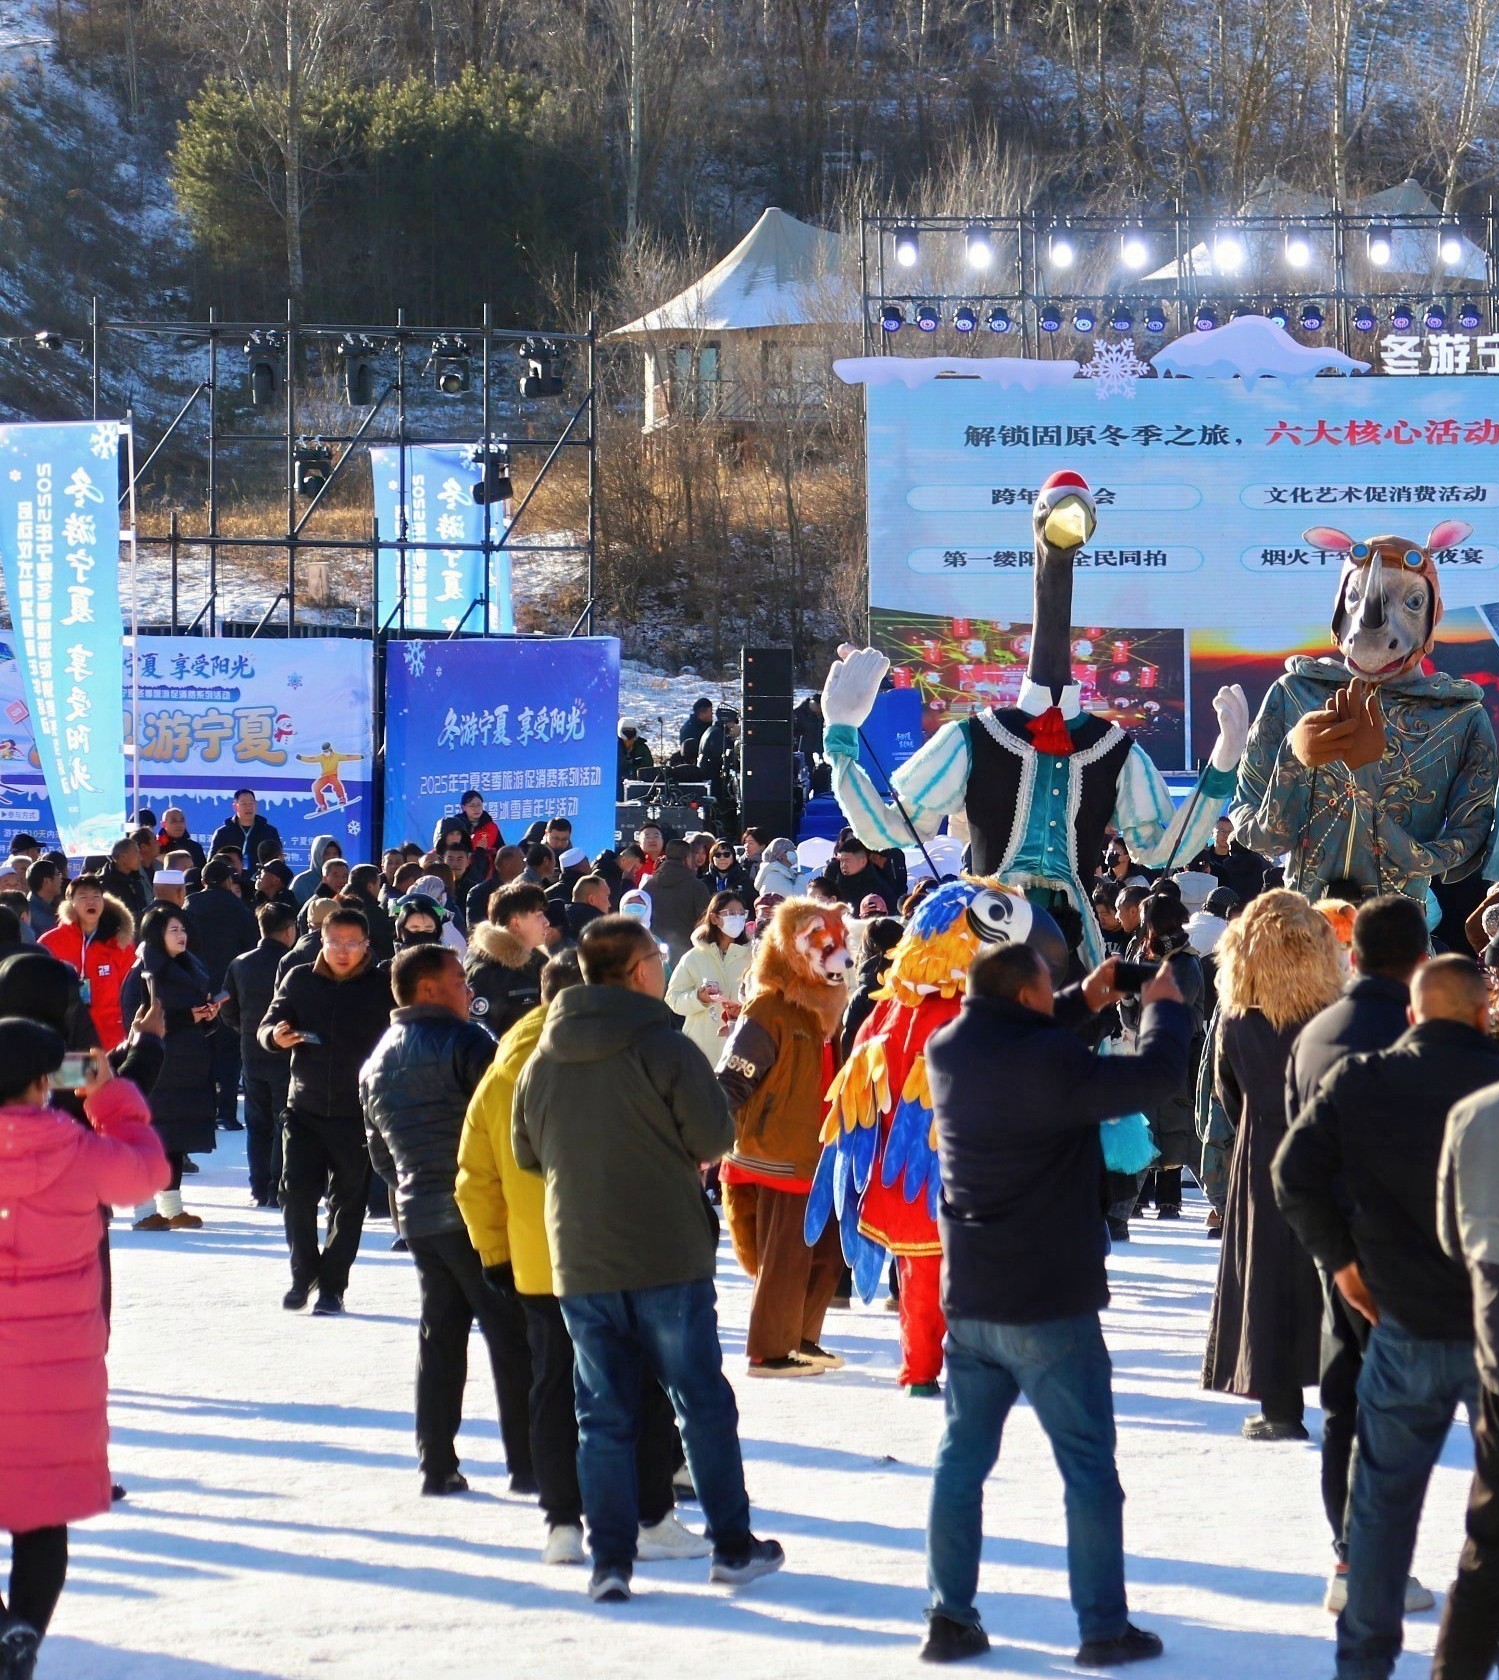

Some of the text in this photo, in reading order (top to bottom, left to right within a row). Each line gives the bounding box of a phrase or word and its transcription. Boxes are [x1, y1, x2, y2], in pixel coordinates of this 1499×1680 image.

[991, 487, 1117, 506] 跨年会
[1263, 485, 1487, 504] 文化艺术促消费活动
[942, 550, 1168, 568] 第一缕阳全民同拍
[170, 653, 256, 681] 享受阳光
[437, 704, 586, 751] 冬游宁夏 享受阳光
